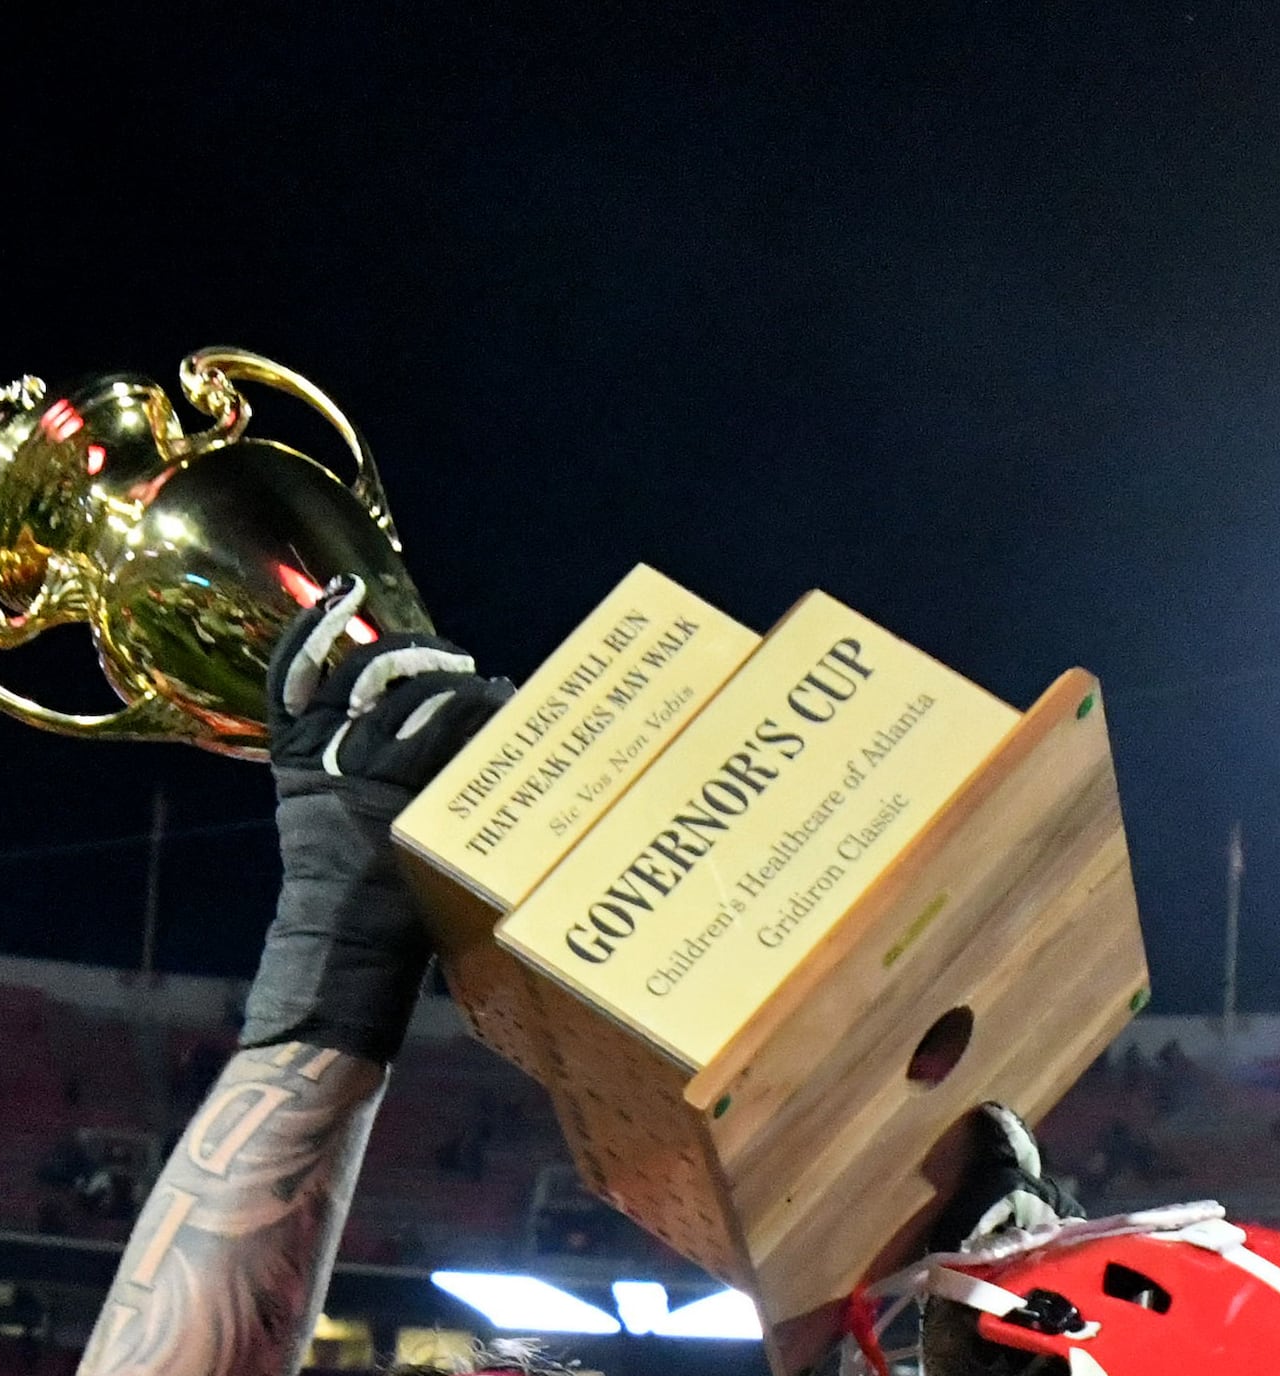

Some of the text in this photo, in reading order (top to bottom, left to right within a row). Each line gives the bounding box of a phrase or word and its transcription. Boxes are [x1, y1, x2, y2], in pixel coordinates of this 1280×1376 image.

[448, 608, 651, 819] STRONG LEGS WILL RUN
[466, 616, 700, 857] THAT WEAK LEGS MAY WALK
[565, 636, 875, 965] GOVERNOR'S CUP
[576, 775, 612, 804] Vos
[611, 735, 650, 773] Non
[645, 685, 695, 732] Vobis
[645, 692, 936, 999] Children's Healthcare of Atlanta
[756, 791, 911, 950] Gridiron Classic
